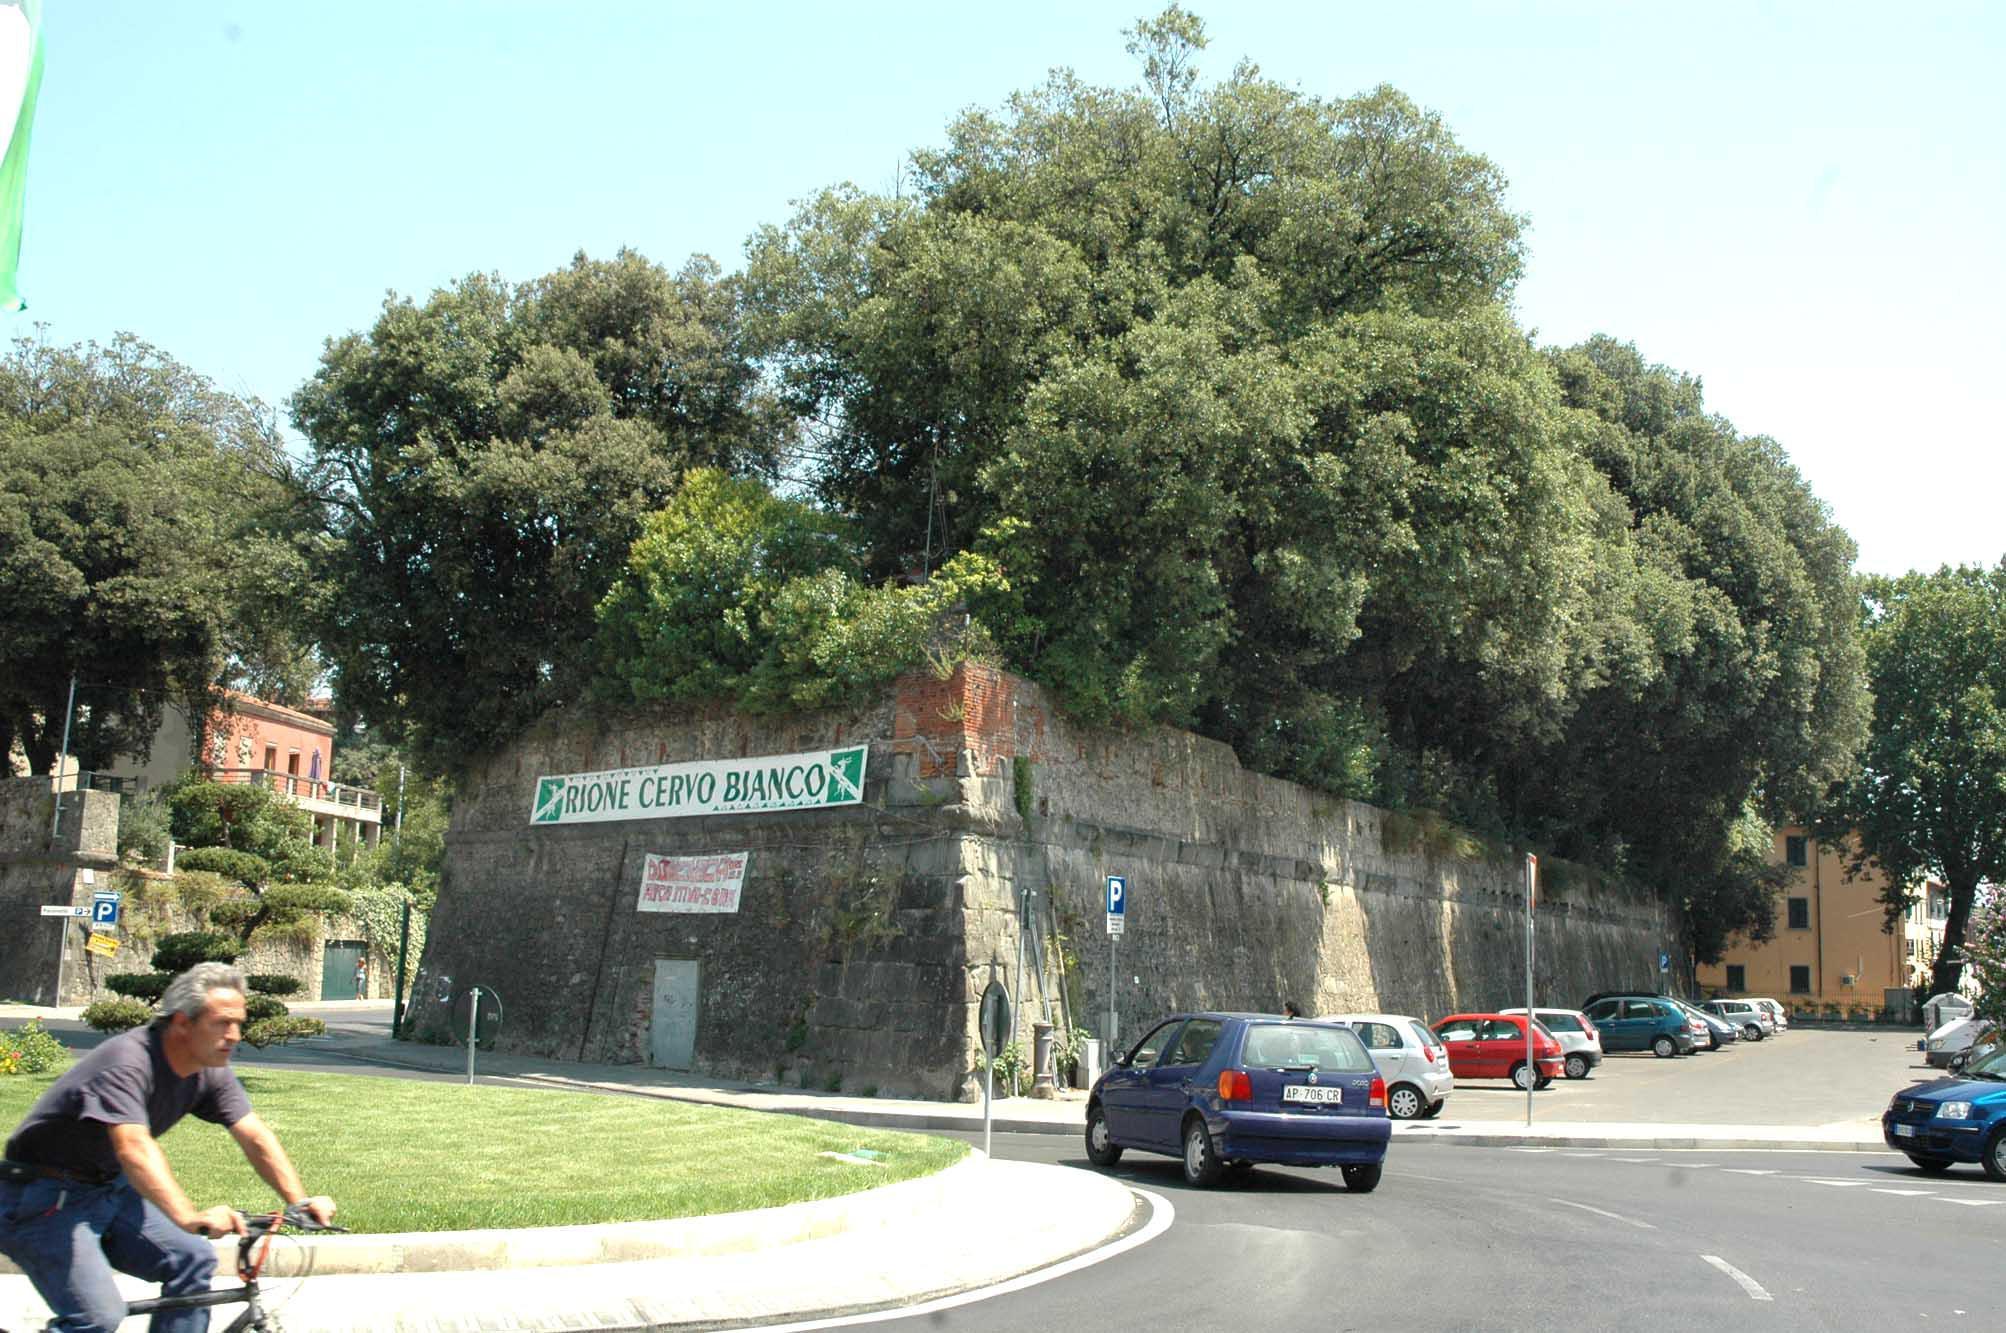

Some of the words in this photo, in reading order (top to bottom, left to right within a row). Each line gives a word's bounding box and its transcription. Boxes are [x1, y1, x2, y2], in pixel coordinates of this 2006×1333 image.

[564, 779, 631, 814] RIONE
[638, 772, 717, 809] CERVO
[723, 763, 827, 803] BIANCO
[1110, 880, 1122, 911] P
[97, 903, 113, 921] P
